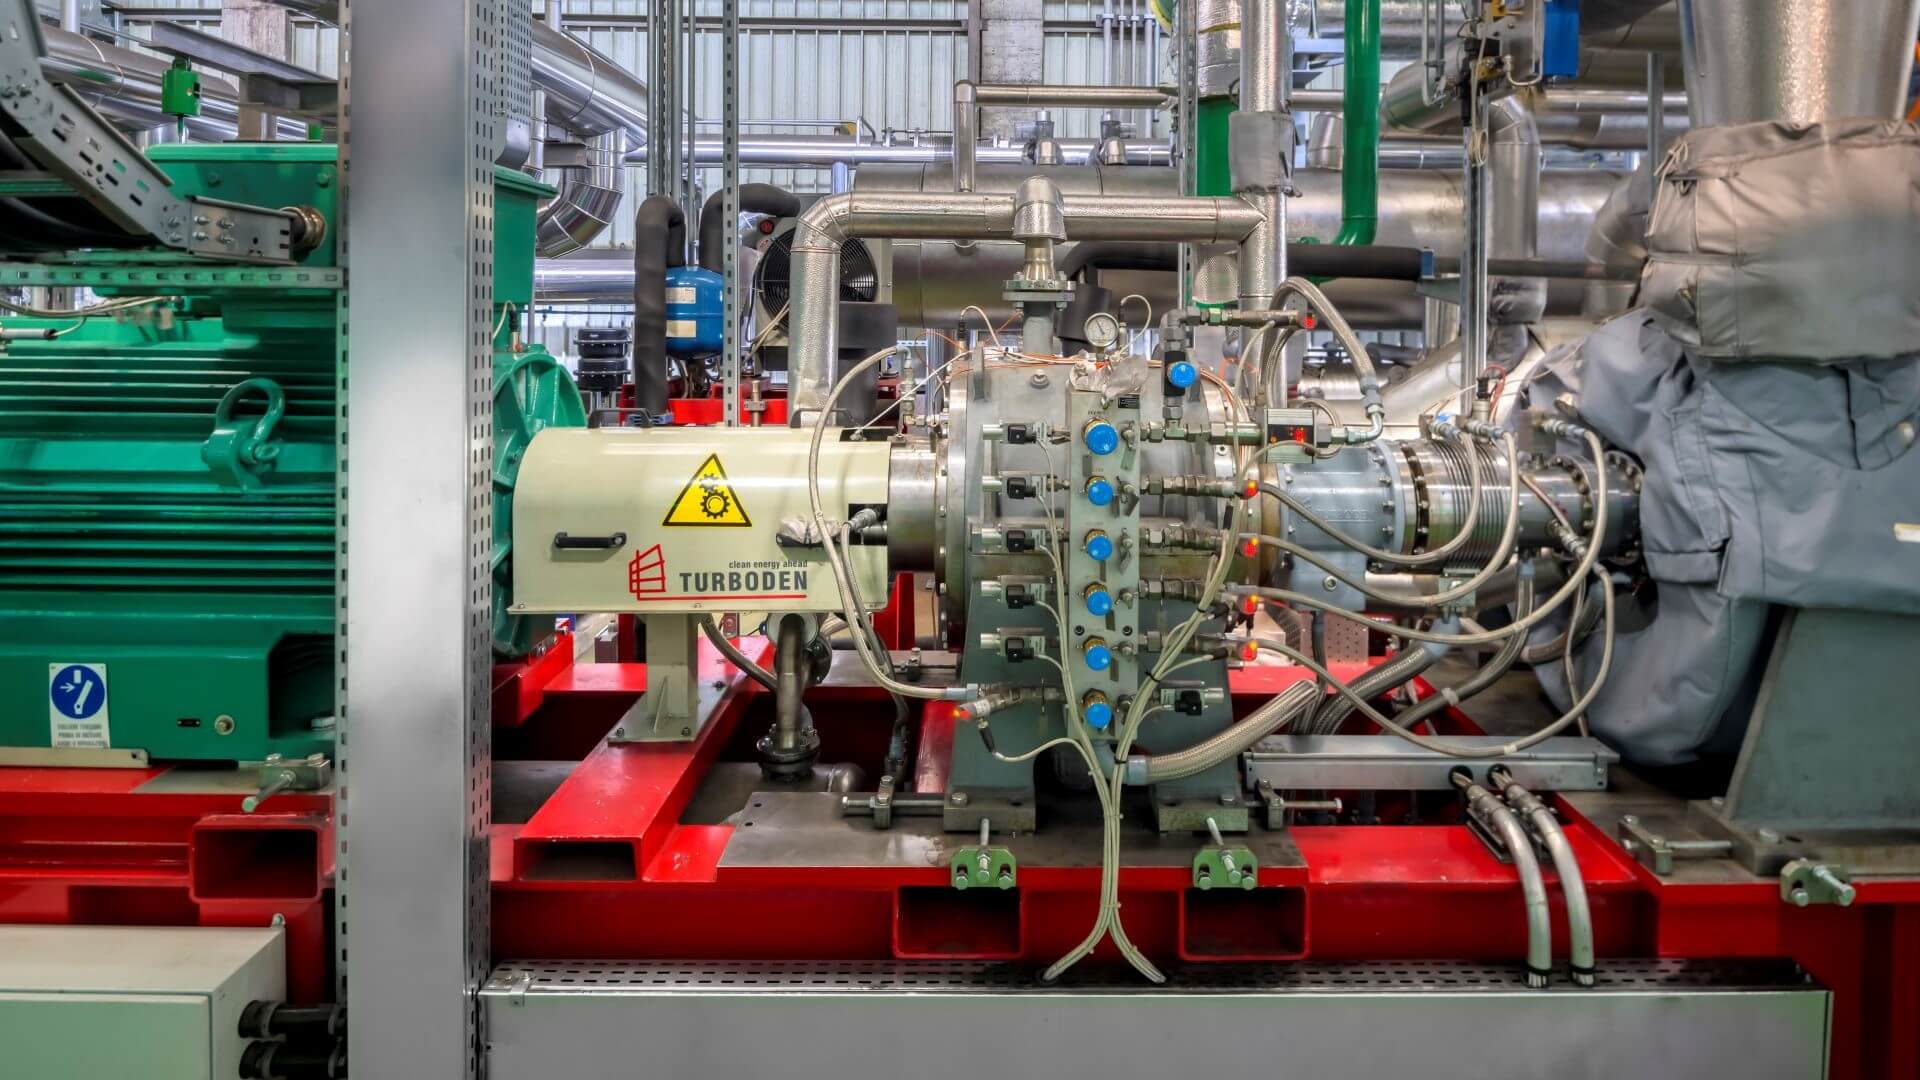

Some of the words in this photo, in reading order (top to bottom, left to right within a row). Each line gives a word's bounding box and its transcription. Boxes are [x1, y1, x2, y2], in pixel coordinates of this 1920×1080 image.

[729, 560, 751, 569] clean
[753, 561, 780, 570] energy
[783, 559, 808, 568] ahead
[679, 570, 808, 593] TURBODEN
